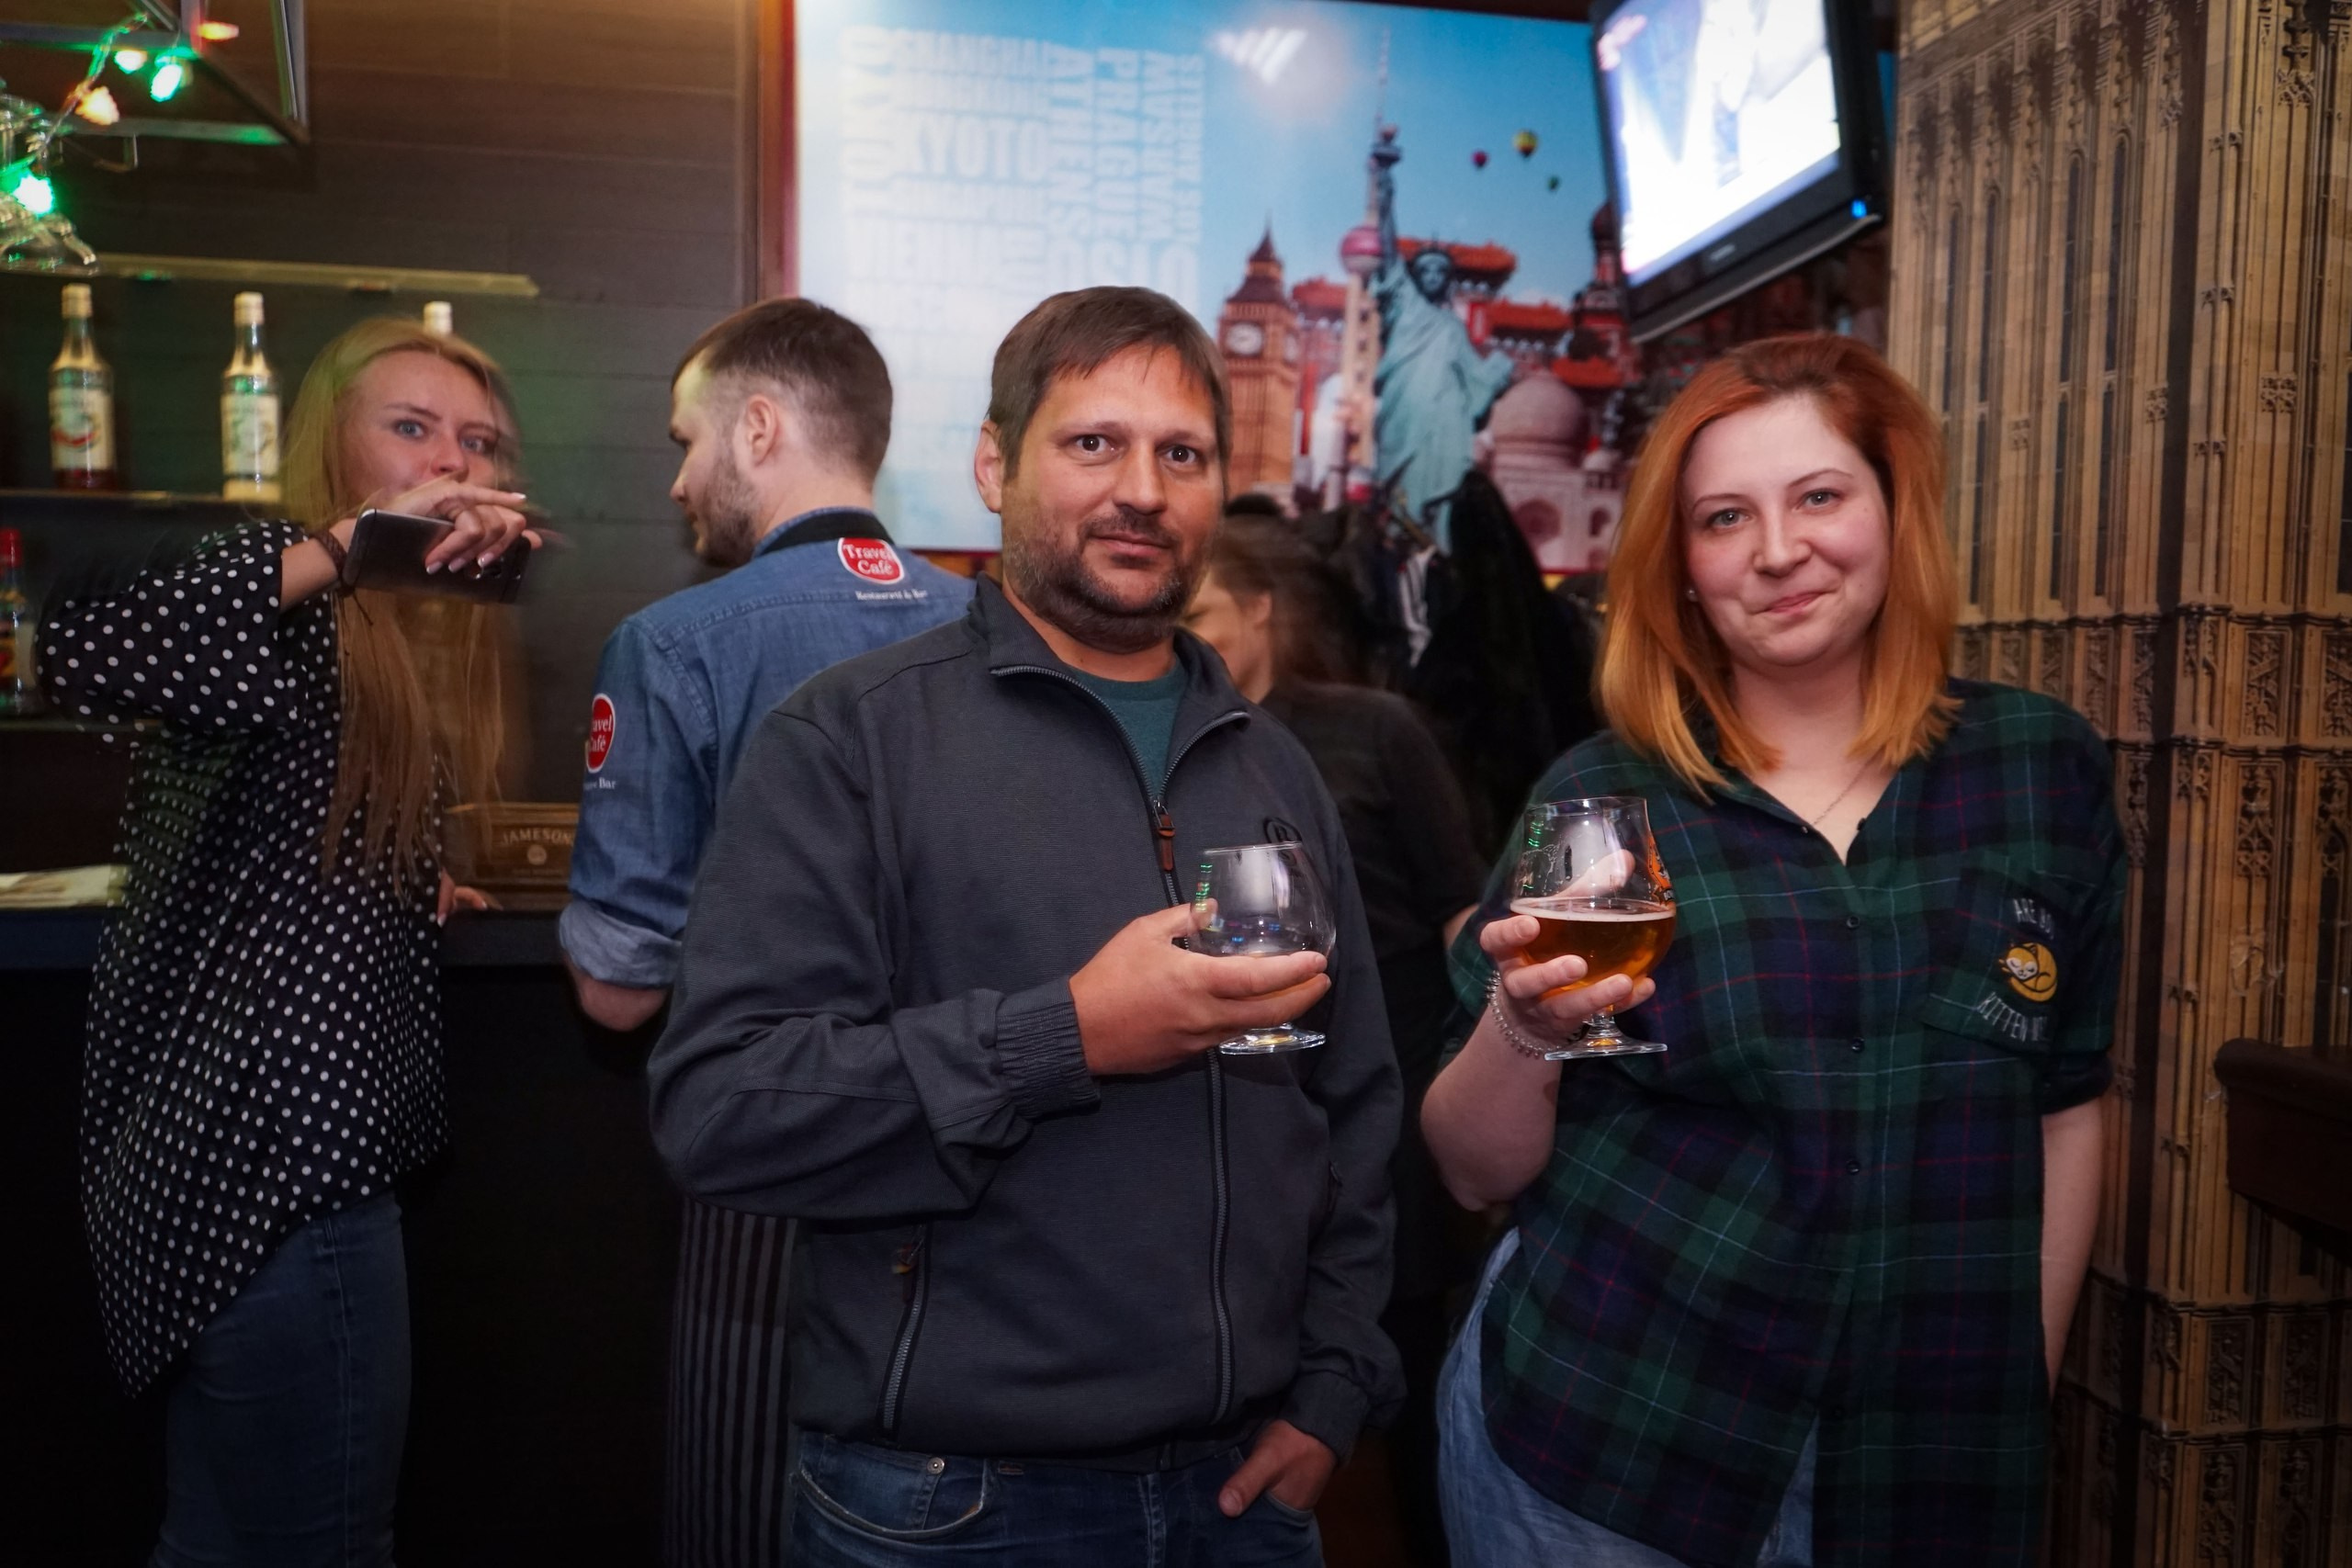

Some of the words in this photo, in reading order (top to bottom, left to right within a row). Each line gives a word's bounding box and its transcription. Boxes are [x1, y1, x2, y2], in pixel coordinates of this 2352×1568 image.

[1046, 40, 1094, 236] ATHENS
[1097, 47, 1139, 239] PRAGUE
[842, 544, 895, 561] Travel
[592, 715, 612, 732] avel
[590, 735, 606, 752] afé
